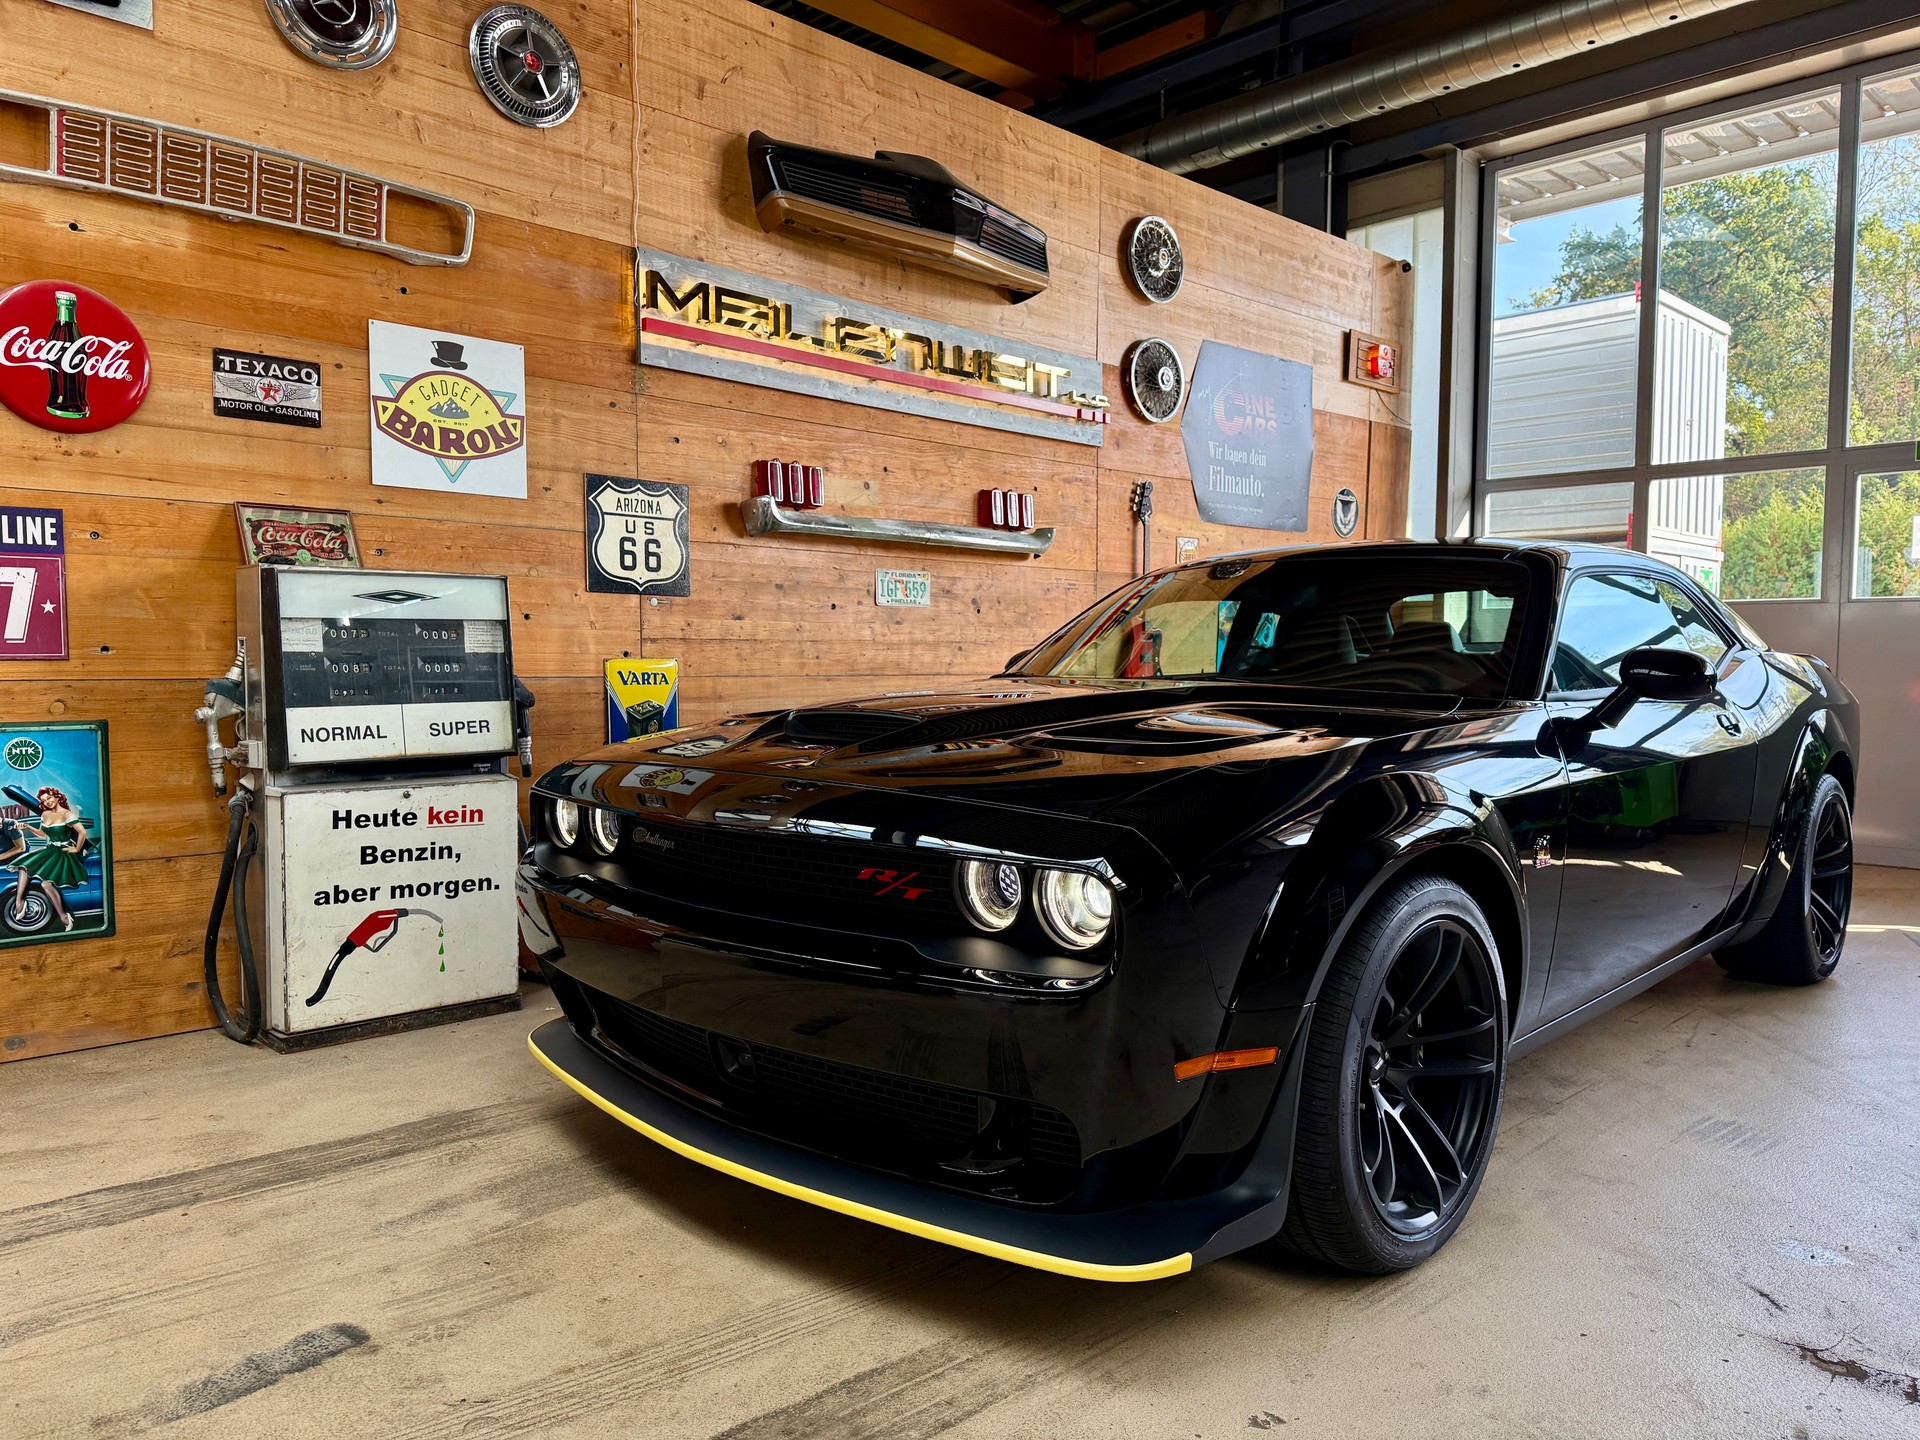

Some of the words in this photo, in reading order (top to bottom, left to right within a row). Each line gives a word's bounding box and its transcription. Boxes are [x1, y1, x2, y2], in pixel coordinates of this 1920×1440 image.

[0, 325, 135, 380] Coca-Cola
[218, 355, 319, 385] TEXACO
[418, 379, 482, 407] GADGET
[220, 399, 253, 411] MOTOR
[254, 404, 269, 413] OIL
[275, 406, 319, 419] GASOLINE
[382, 404, 519, 455] BARON
[1208, 440, 1223, 460] Wir
[1224, 443, 1248, 464] bauen
[1249, 447, 1267, 467] dein
[1208, 464, 1265, 498] Filmauto.
[615, 496, 662, 515] ARIZONA
[1, 514, 58, 546] LINE
[256, 526, 343, 549] Coca-Cola
[619, 536, 662, 573] 66
[891, 571, 917, 579] FLORIDA
[880, 578, 901, 598] IGF
[905, 579, 927, 599] 559
[0, 566, 37, 643] 7
[617, 670, 670, 686] VARTA
[301, 725, 388, 743] NORMAL
[429, 720, 491, 737] SUPER
[11, 747, 36, 756] NTK
[332, 808, 418, 830] Heute
[427, 805, 485, 826] kein
[360, 842, 462, 866] Benzin,
[313, 884, 381, 906] aber
[390, 876, 500, 900] morgen.
[857, 865, 934, 900] R/T
